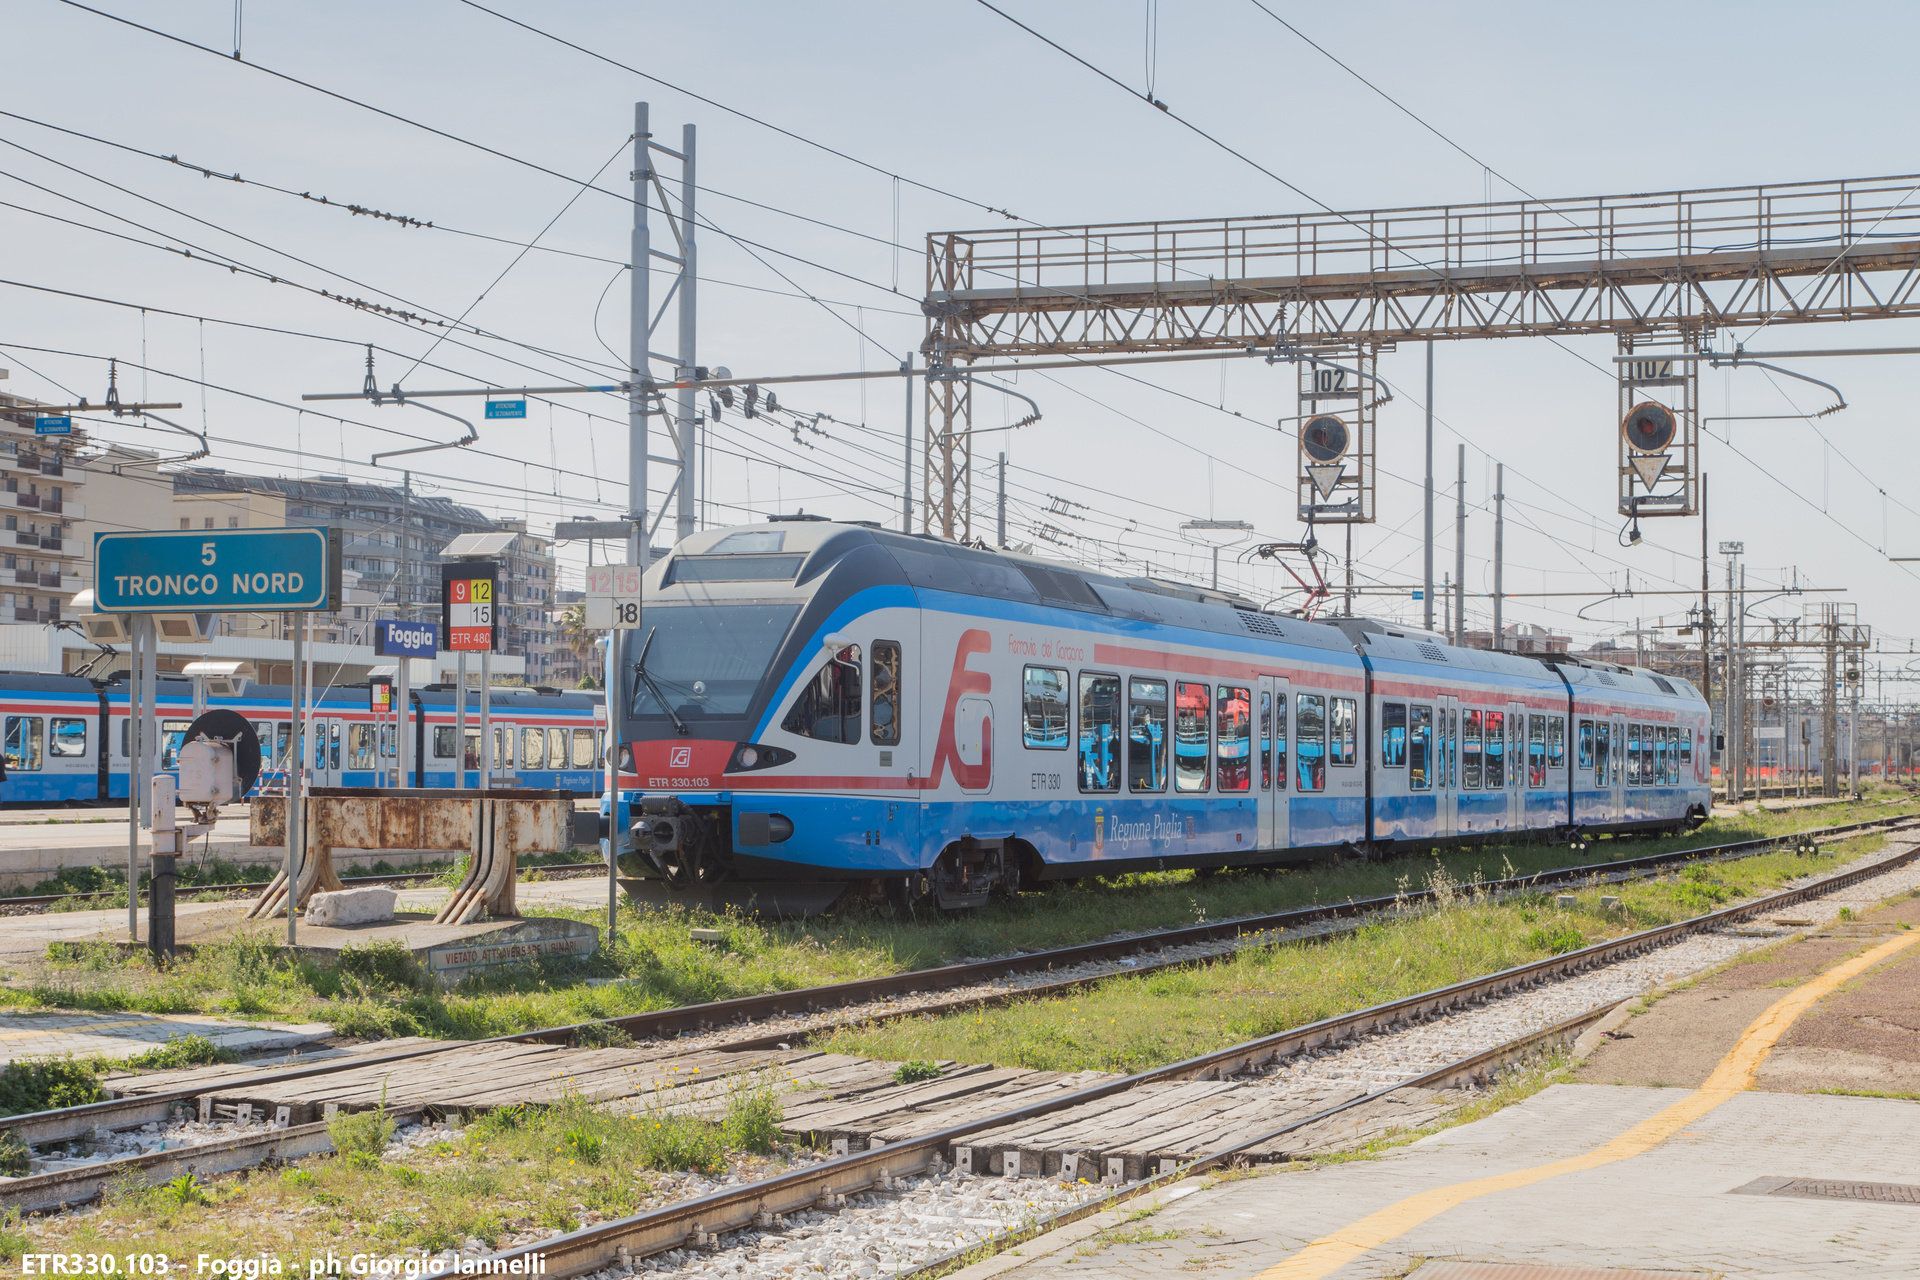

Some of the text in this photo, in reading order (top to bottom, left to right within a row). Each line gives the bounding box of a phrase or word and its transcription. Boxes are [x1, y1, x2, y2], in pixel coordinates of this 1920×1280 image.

[1637, 360, 1670, 379] 102
[1314, 369, 1345, 392] 102
[201, 542, 217, 566] 5
[114, 572, 304, 597] TRONCO NORD
[456, 583, 466, 600] 9
[473, 582, 490, 600] 12
[587, 572, 611, 593] 12
[615, 572, 639, 593] 15
[473, 606, 490, 624] 15
[616, 603, 638, 623] 18
[388, 623, 433, 649] Foggia
[451, 633, 490, 644] ETR 480
[1008, 633, 1084, 664] Ferrovie del Gargano
[381, 685, 389, 693] 12
[381, 694, 389, 702] 15
[648, 777, 710, 787] ETR 330.103
[1031, 773, 1061, 790] ETR 330
[1109, 812, 1183, 850] Regione Puglia
[445, 950, 478, 965] VIETATO
